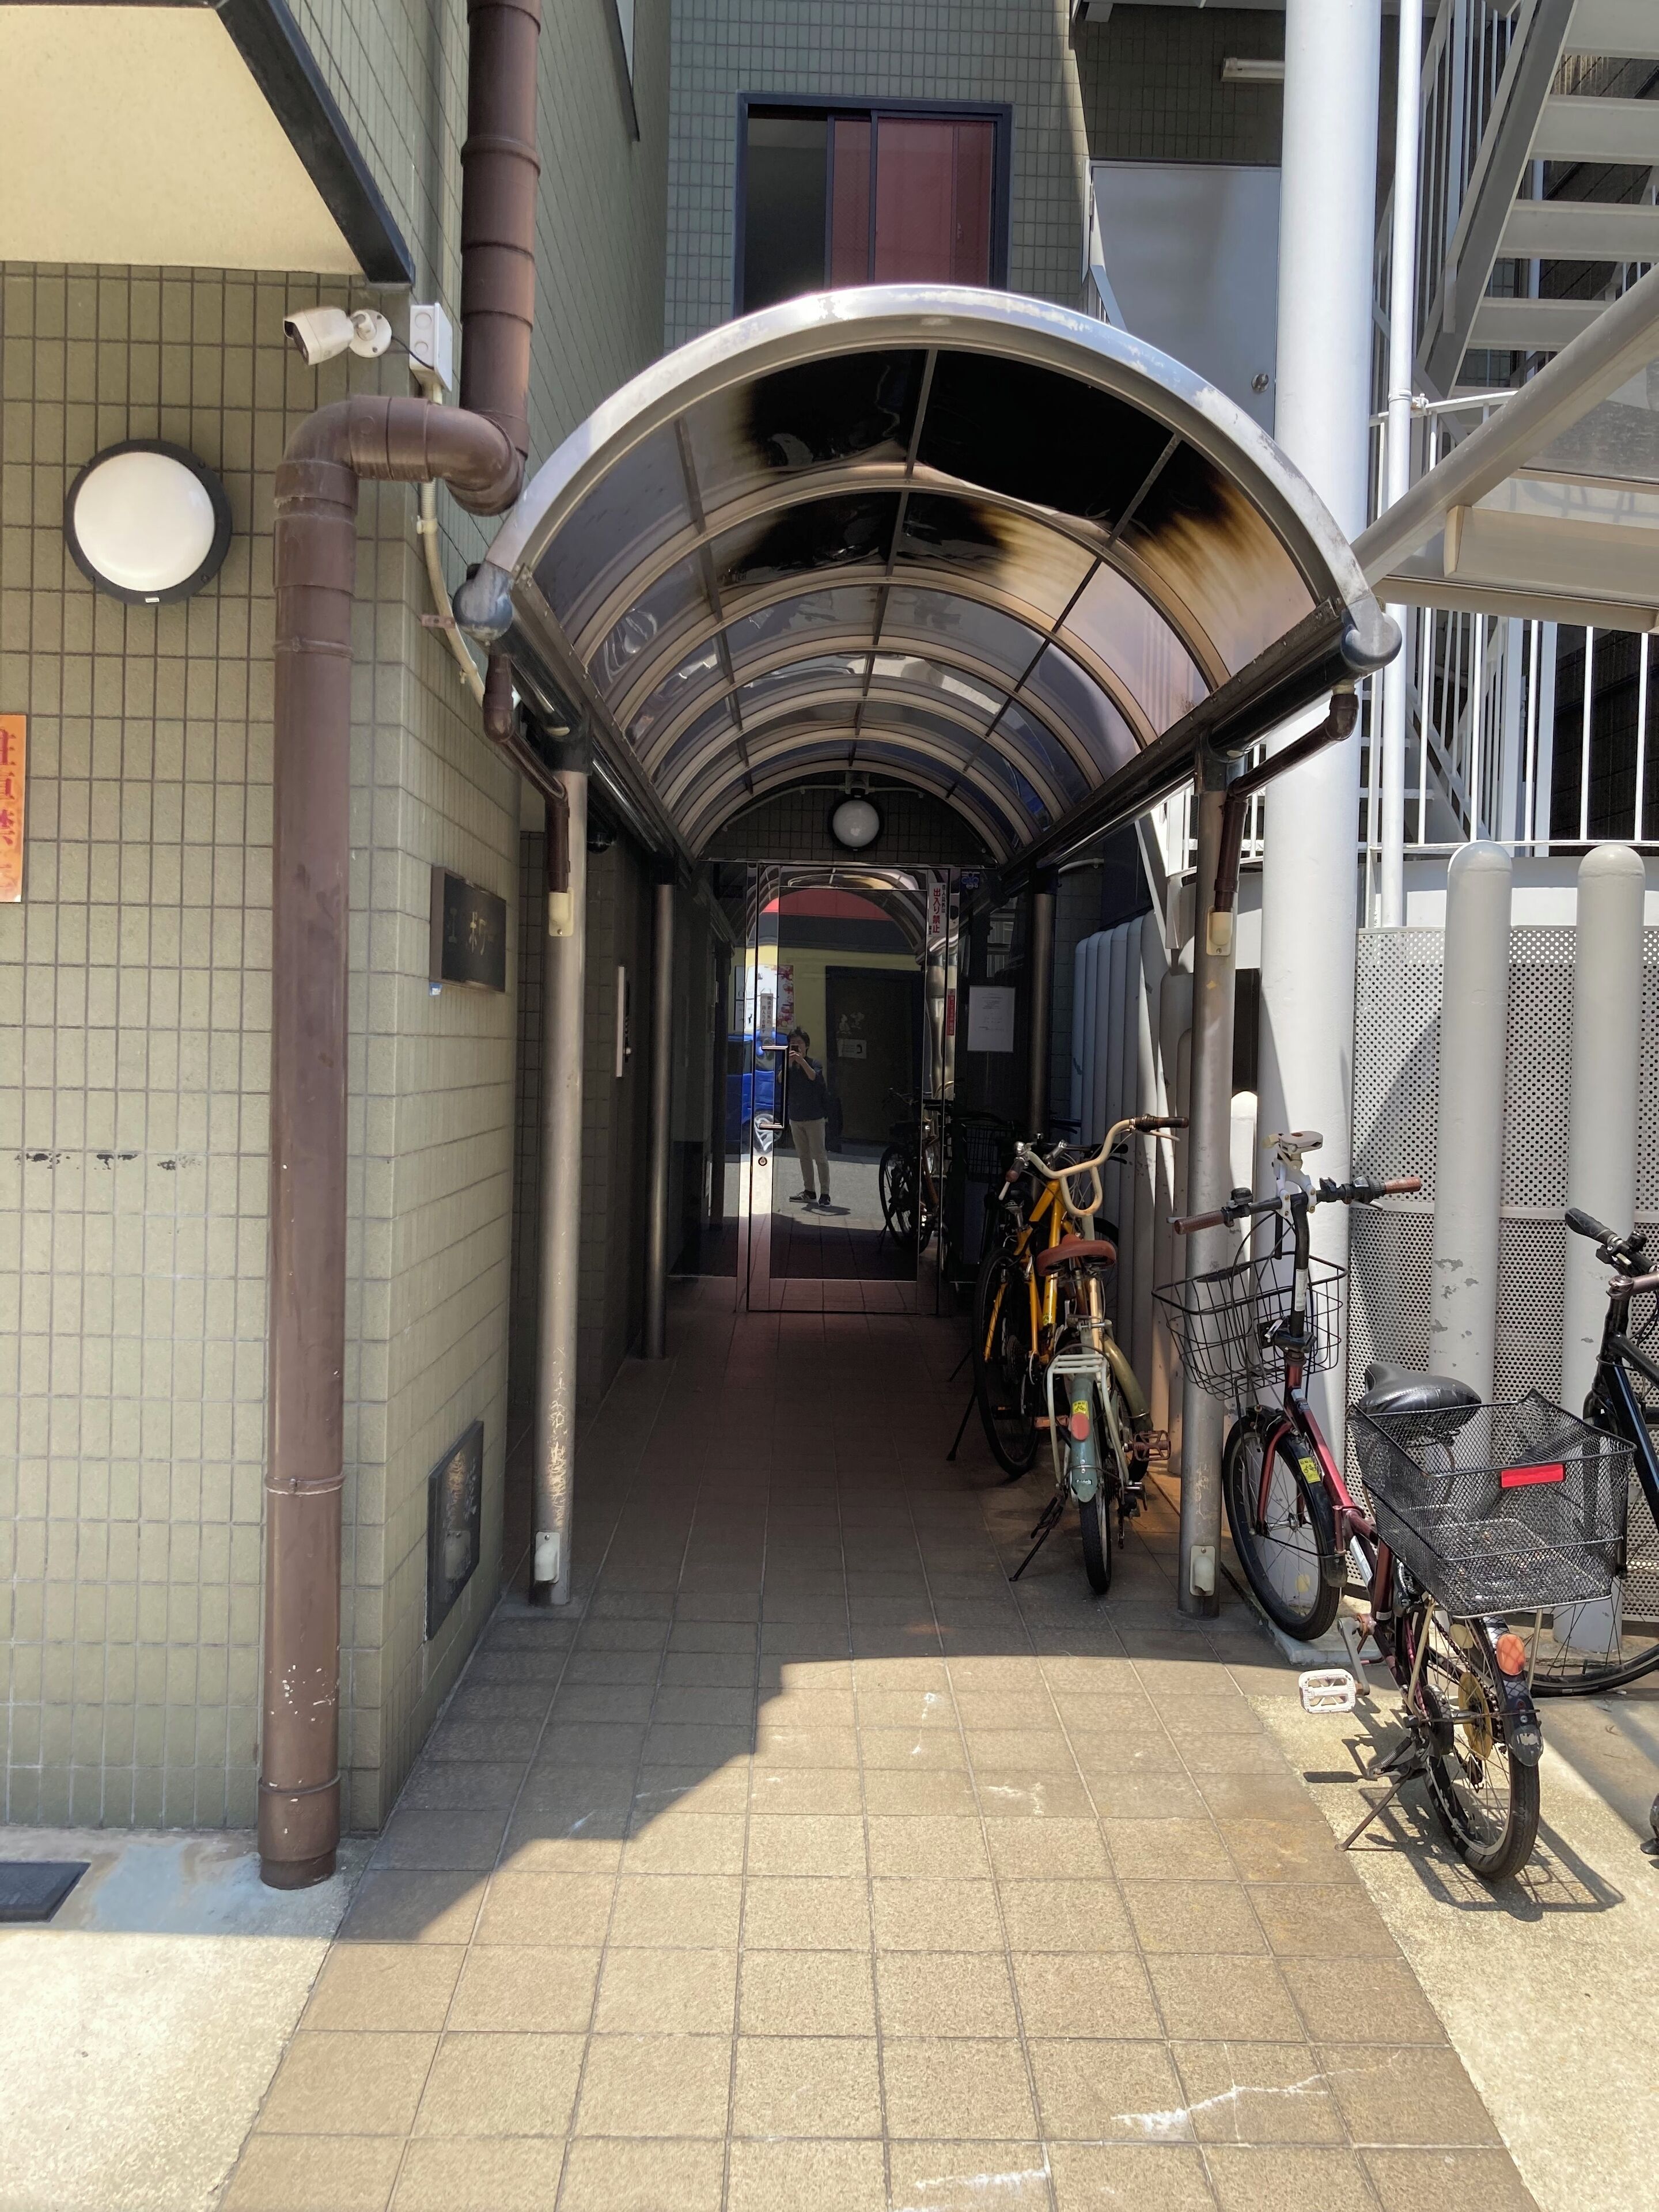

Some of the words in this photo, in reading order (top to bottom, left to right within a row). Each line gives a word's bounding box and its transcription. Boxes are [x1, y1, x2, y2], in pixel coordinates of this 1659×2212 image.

[932, 888, 941, 933] 出入り禁止
